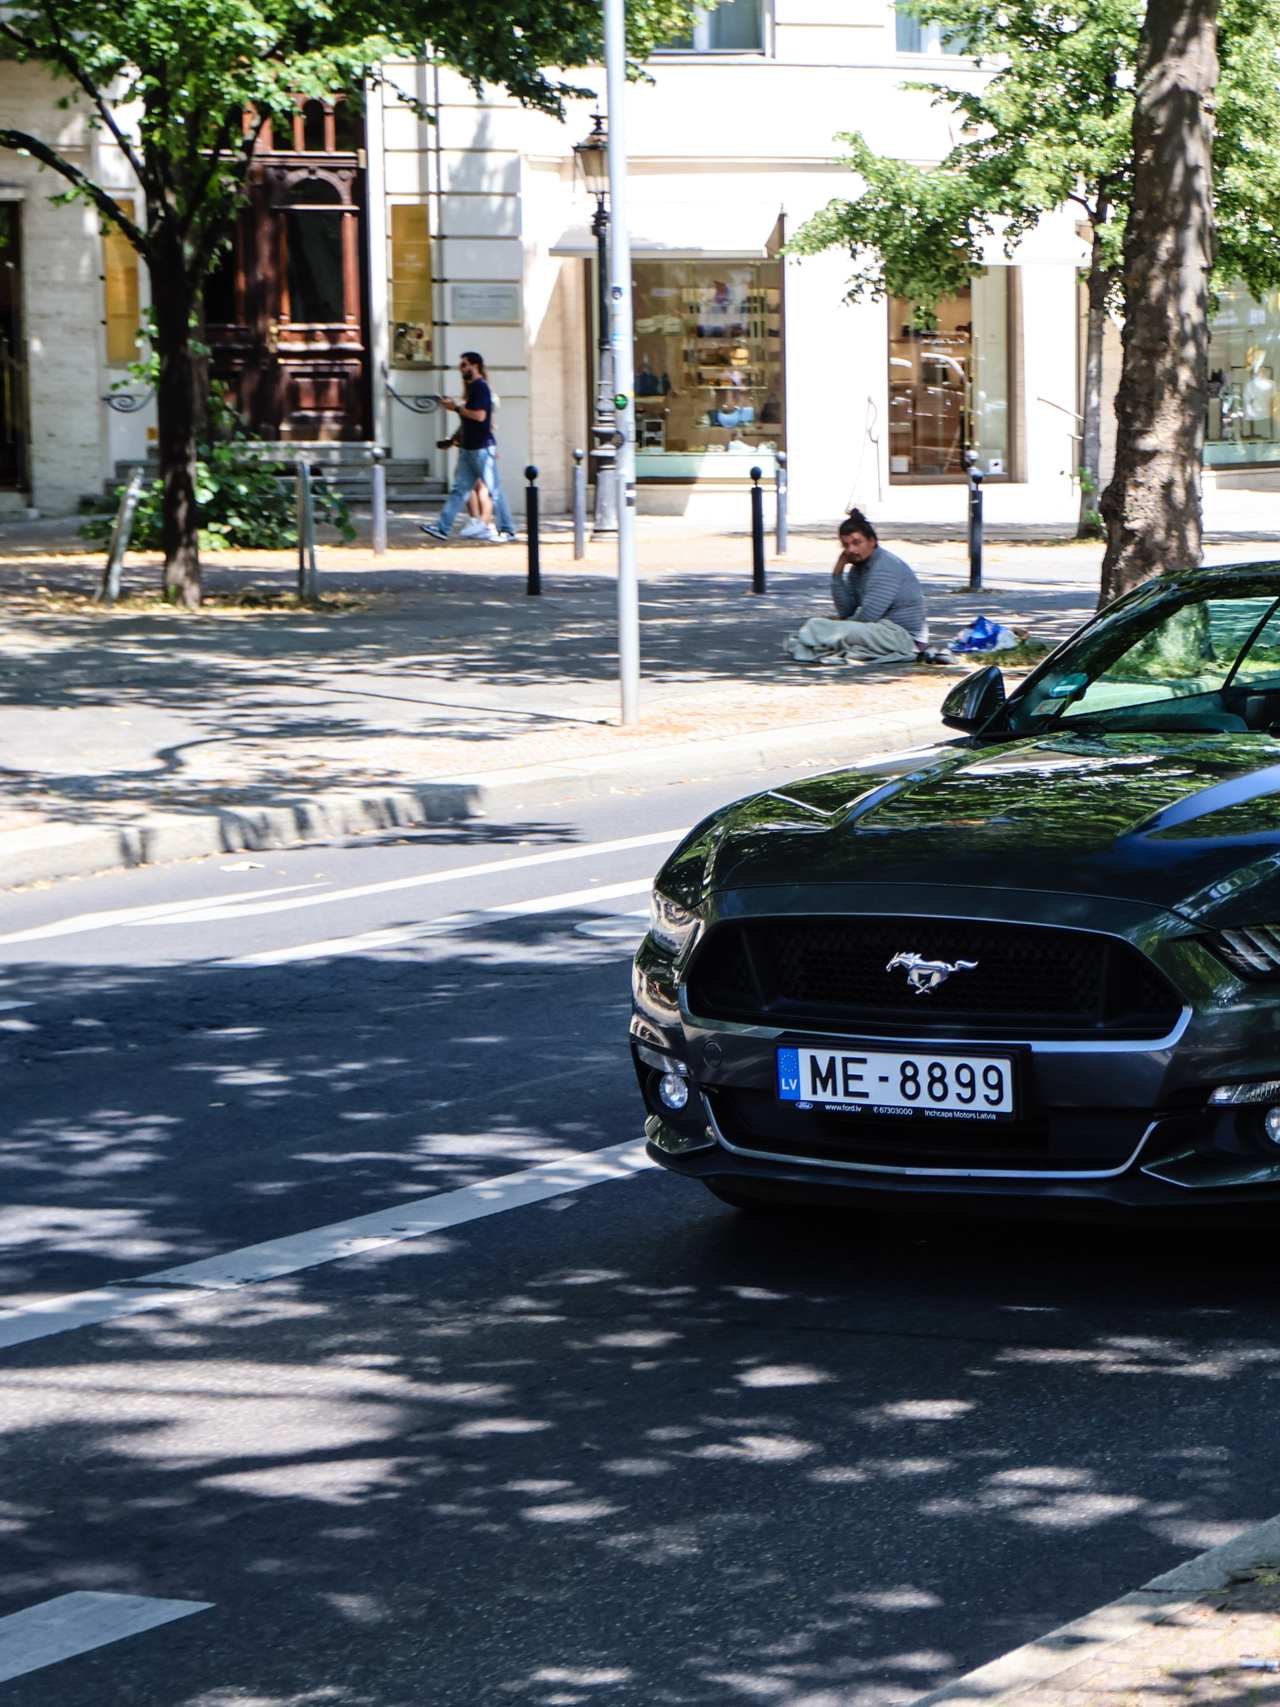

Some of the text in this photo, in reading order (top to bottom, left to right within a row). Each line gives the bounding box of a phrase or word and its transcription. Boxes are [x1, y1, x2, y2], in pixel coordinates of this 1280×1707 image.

[781, 1078, 798, 1092] LV
[809, 1054, 1005, 1107] ME-8899
[824, 1103, 862, 1113] www.ford.lv
[924, 1109, 953, 1119] Inchcape
[953, 1110, 976, 1119] Motors
[976, 1112, 996, 1120] Latvia
